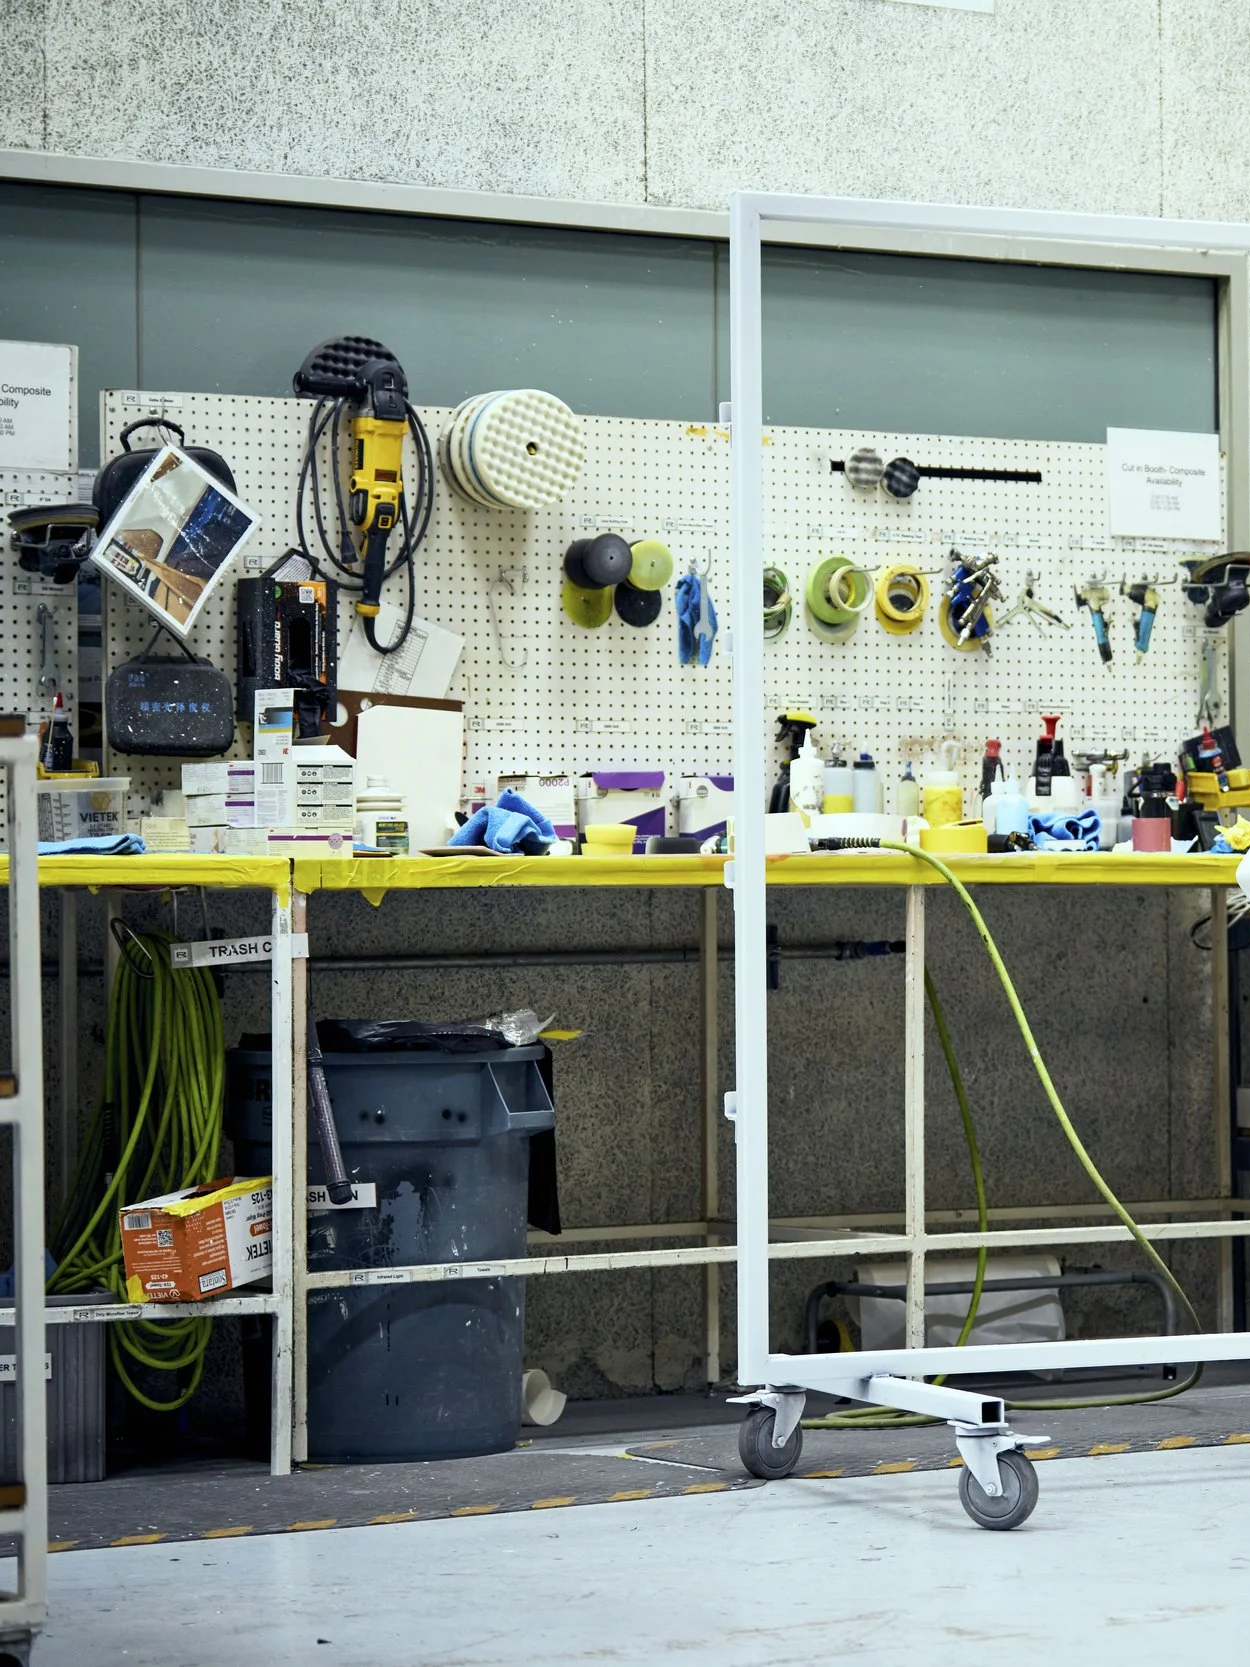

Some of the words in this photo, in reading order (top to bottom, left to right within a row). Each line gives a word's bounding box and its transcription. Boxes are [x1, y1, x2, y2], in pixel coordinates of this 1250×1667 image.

[1, 384, 52, 396] Composite
[1122, 463, 1135, 471] Cut
[1169, 466, 1206, 476] Composite
[538, 778, 570, 787] P2000
[79, 811, 119, 822] VIETEK
[208, 943, 259, 958] TRASH
[251, 1189, 272, 1205] 3-125
[253, 1222, 271, 1234] -Towel
[246, 1239, 272, 1262] IETEK
[201, 1271, 226, 1288] Sontara
[392, 1273, 404, 1281] Light
[145, 1291, 169, 1299] VIETE
